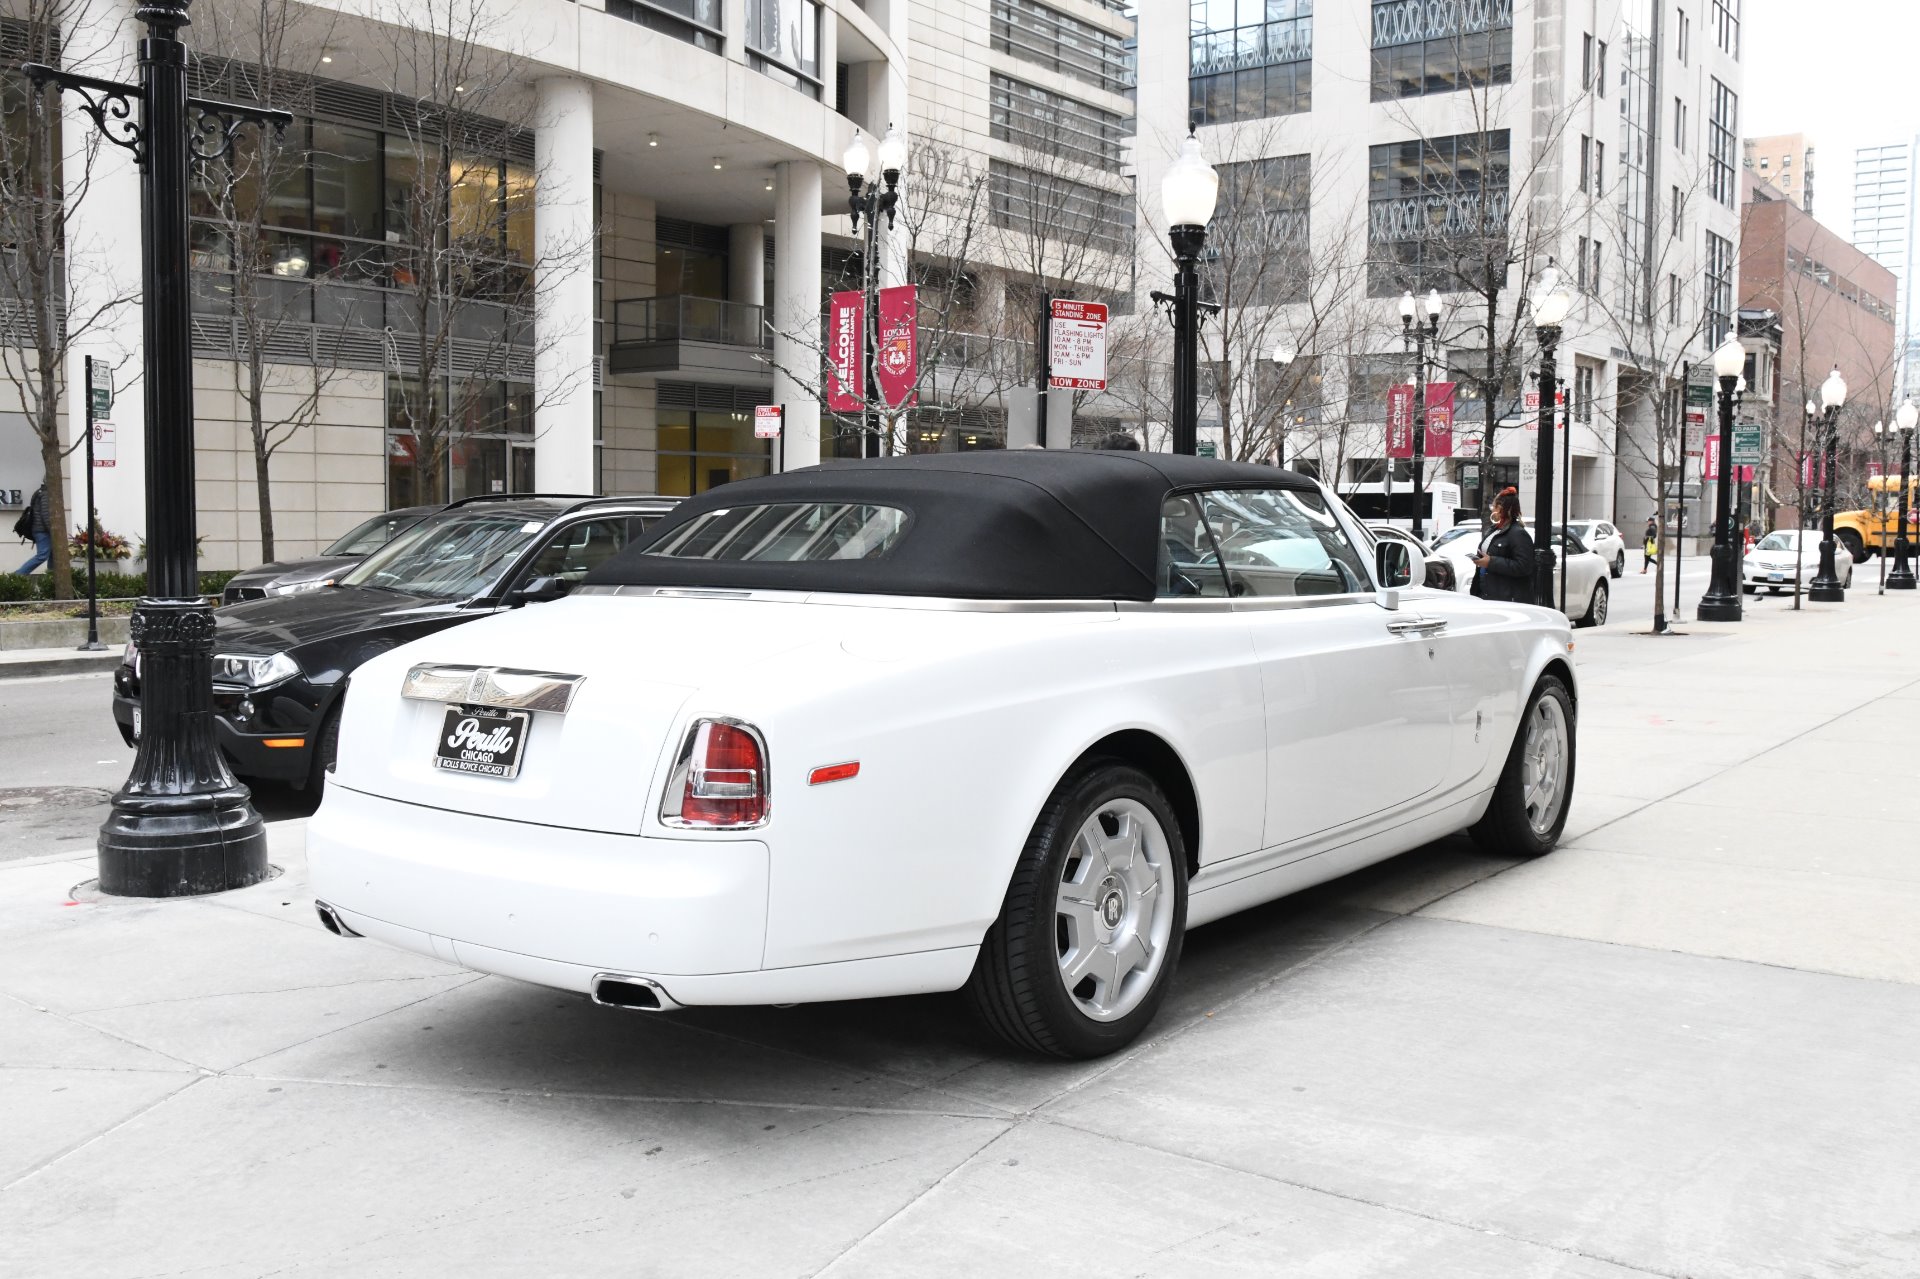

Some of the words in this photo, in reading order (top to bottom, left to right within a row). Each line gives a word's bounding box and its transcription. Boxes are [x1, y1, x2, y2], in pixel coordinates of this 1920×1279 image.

[908, 142, 973, 188] YOLA
[1063, 303, 1084, 311] MINUTE
[1055, 310, 1083, 319] STANDING
[1054, 321, 1066, 329] USE
[883, 328, 911, 337] LOYOLA
[1054, 329, 1083, 337] FLASHING
[1084, 331, 1104, 339] LIGHTS
[838, 307, 850, 397] WELCOME
[1074, 345, 1094, 353] THURS
[1053, 377, 1073, 387] TOW
[1077, 379, 1101, 389] ZONE
[1392, 393, 1402, 449] WELCOME
[471, 707, 498, 717] Perillo
[447, 717, 514, 754] Perillo
[461, 749, 494, 763] CHICAGO
[442, 759, 459, 769] ROLLS
[460, 761, 478, 772] ROYCE
[478, 764, 503, 775] CHICAGO
